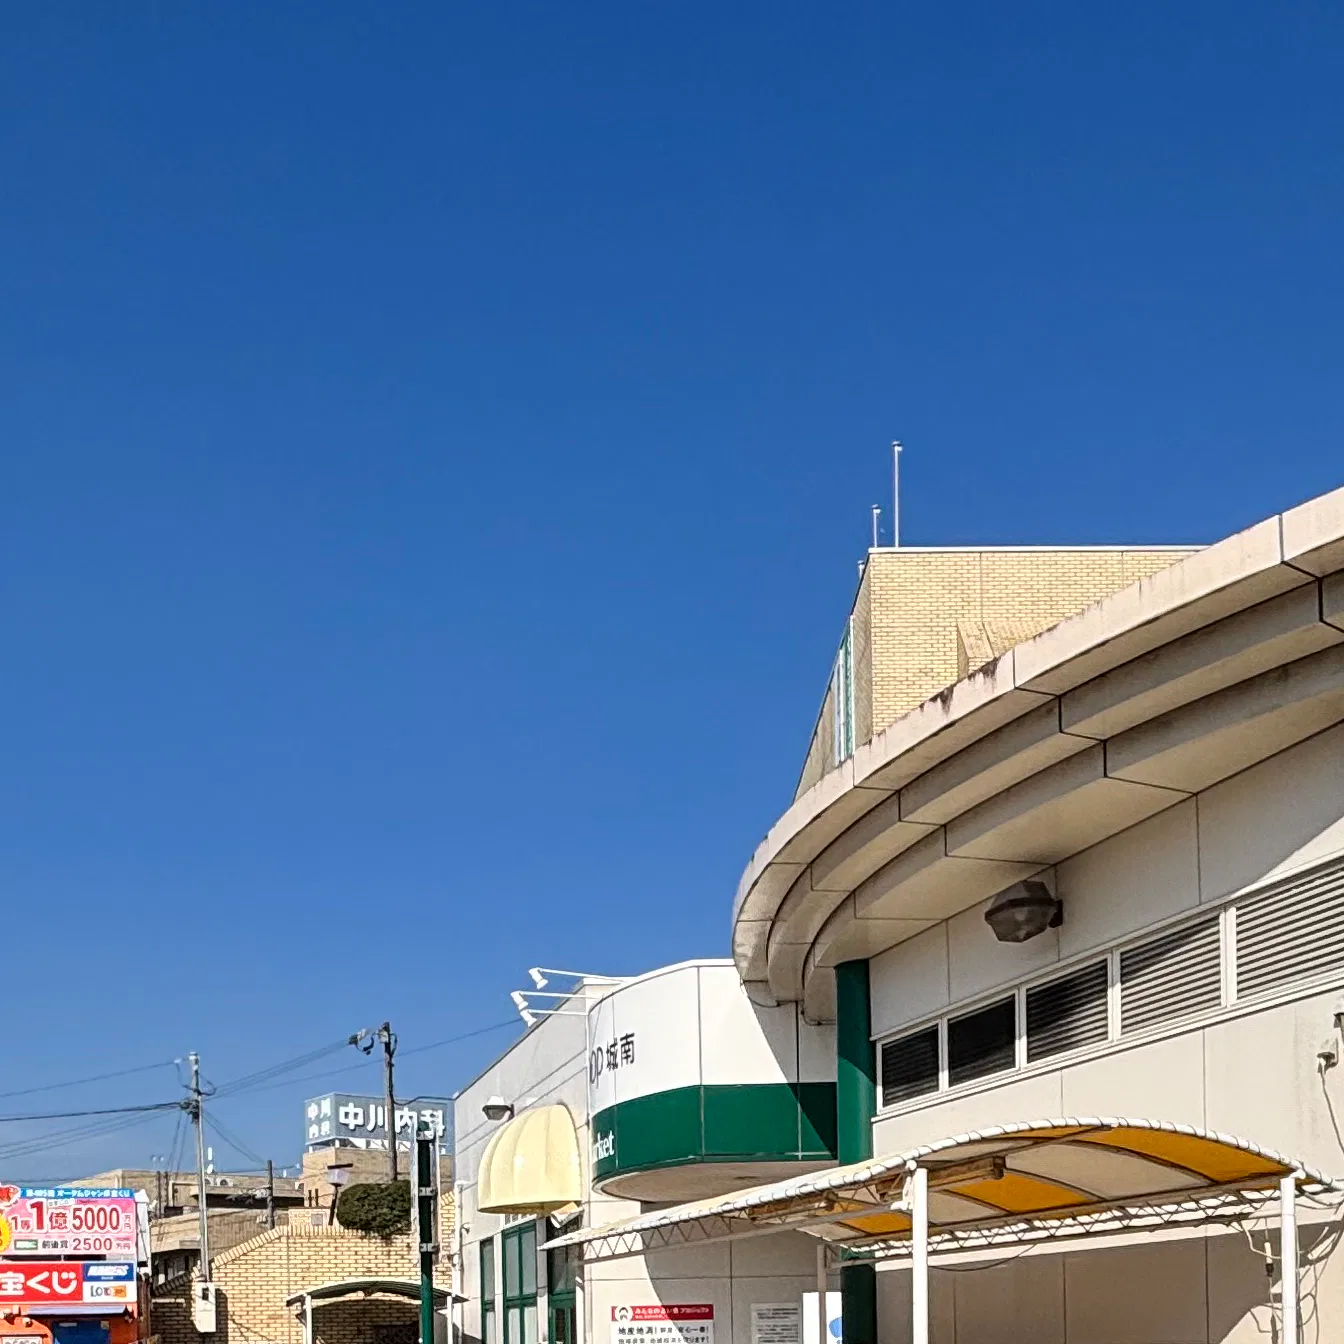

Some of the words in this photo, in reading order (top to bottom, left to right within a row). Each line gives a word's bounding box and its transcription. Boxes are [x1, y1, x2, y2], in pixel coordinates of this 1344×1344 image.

[606, 1032, 635, 1072] 城南
[339, 1103, 445, 1137] 中川内科
